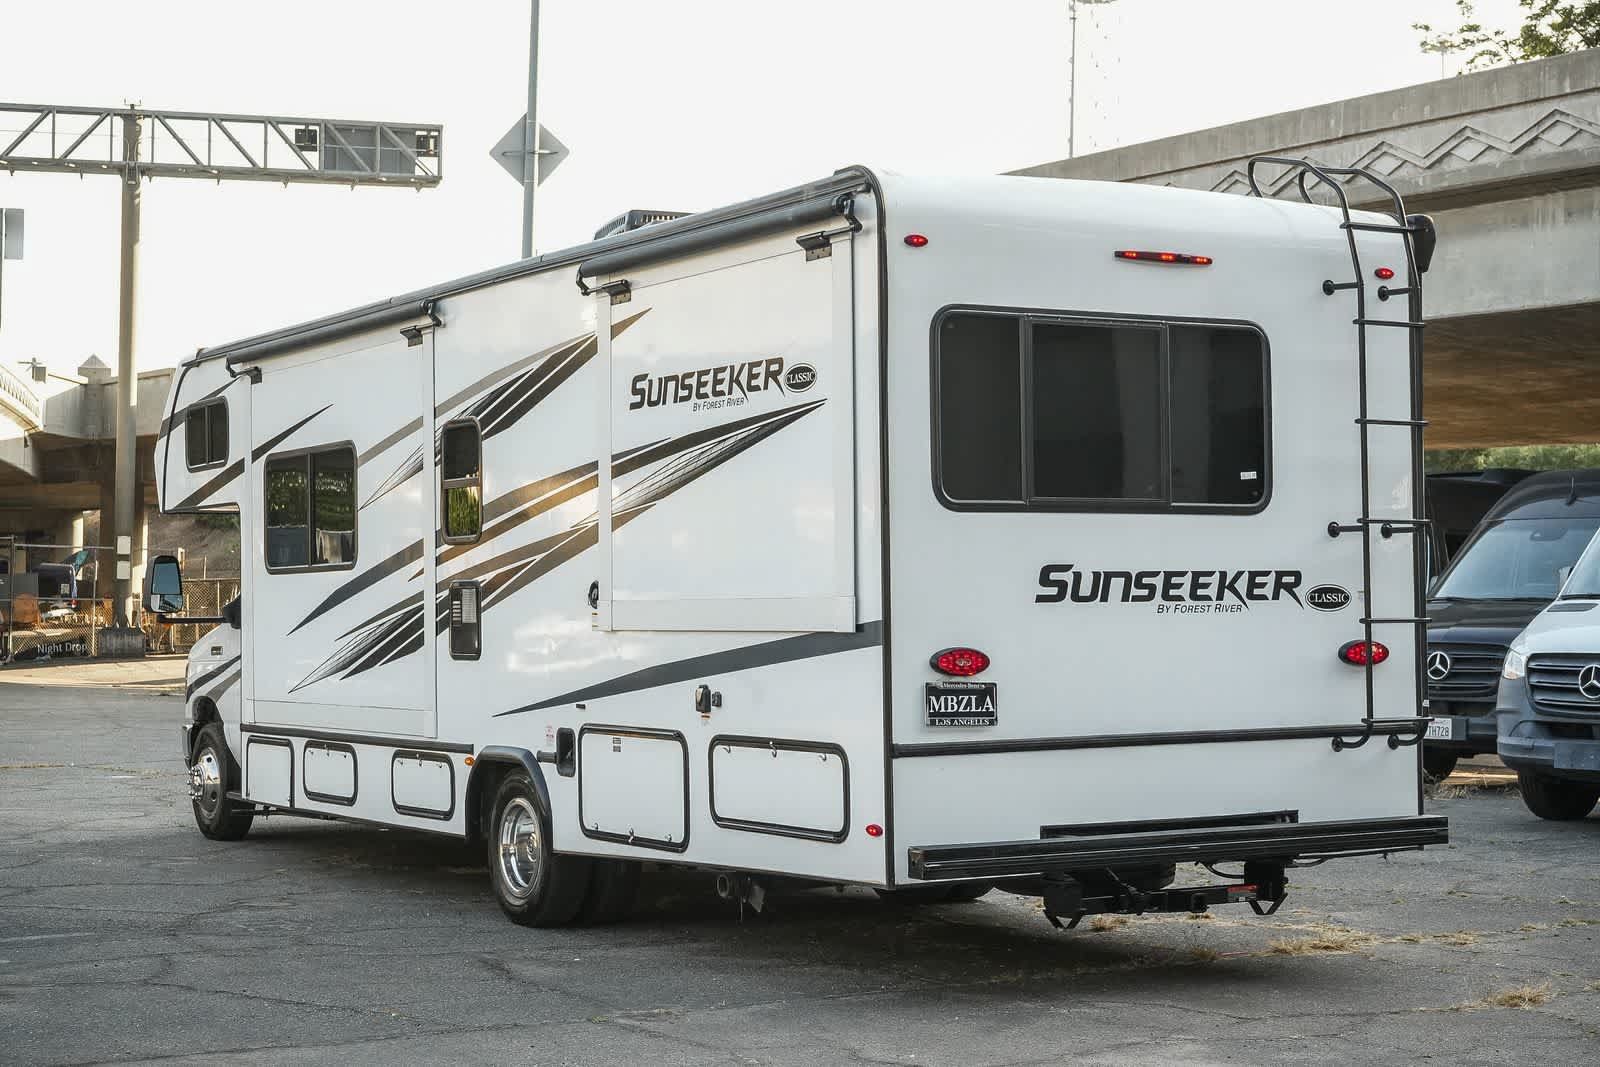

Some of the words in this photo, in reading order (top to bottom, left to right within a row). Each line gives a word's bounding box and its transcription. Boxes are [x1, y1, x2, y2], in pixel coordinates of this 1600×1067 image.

[785, 369, 815, 385] CLASSIC
[693, 402, 702, 412] BY
[702, 400, 725, 411] FOREST
[727, 397, 745, 408] RIVER
[1308, 592, 1348, 604] CLASSIC
[1157, 604, 1171, 614] BY
[1173, 603, 1210, 614] FOREST
[1214, 603, 1242, 613] RIVER
[37, 643, 62, 654] Night
[65, 641, 87, 654] Drop
[929, 695, 994, 712] MBZLA
